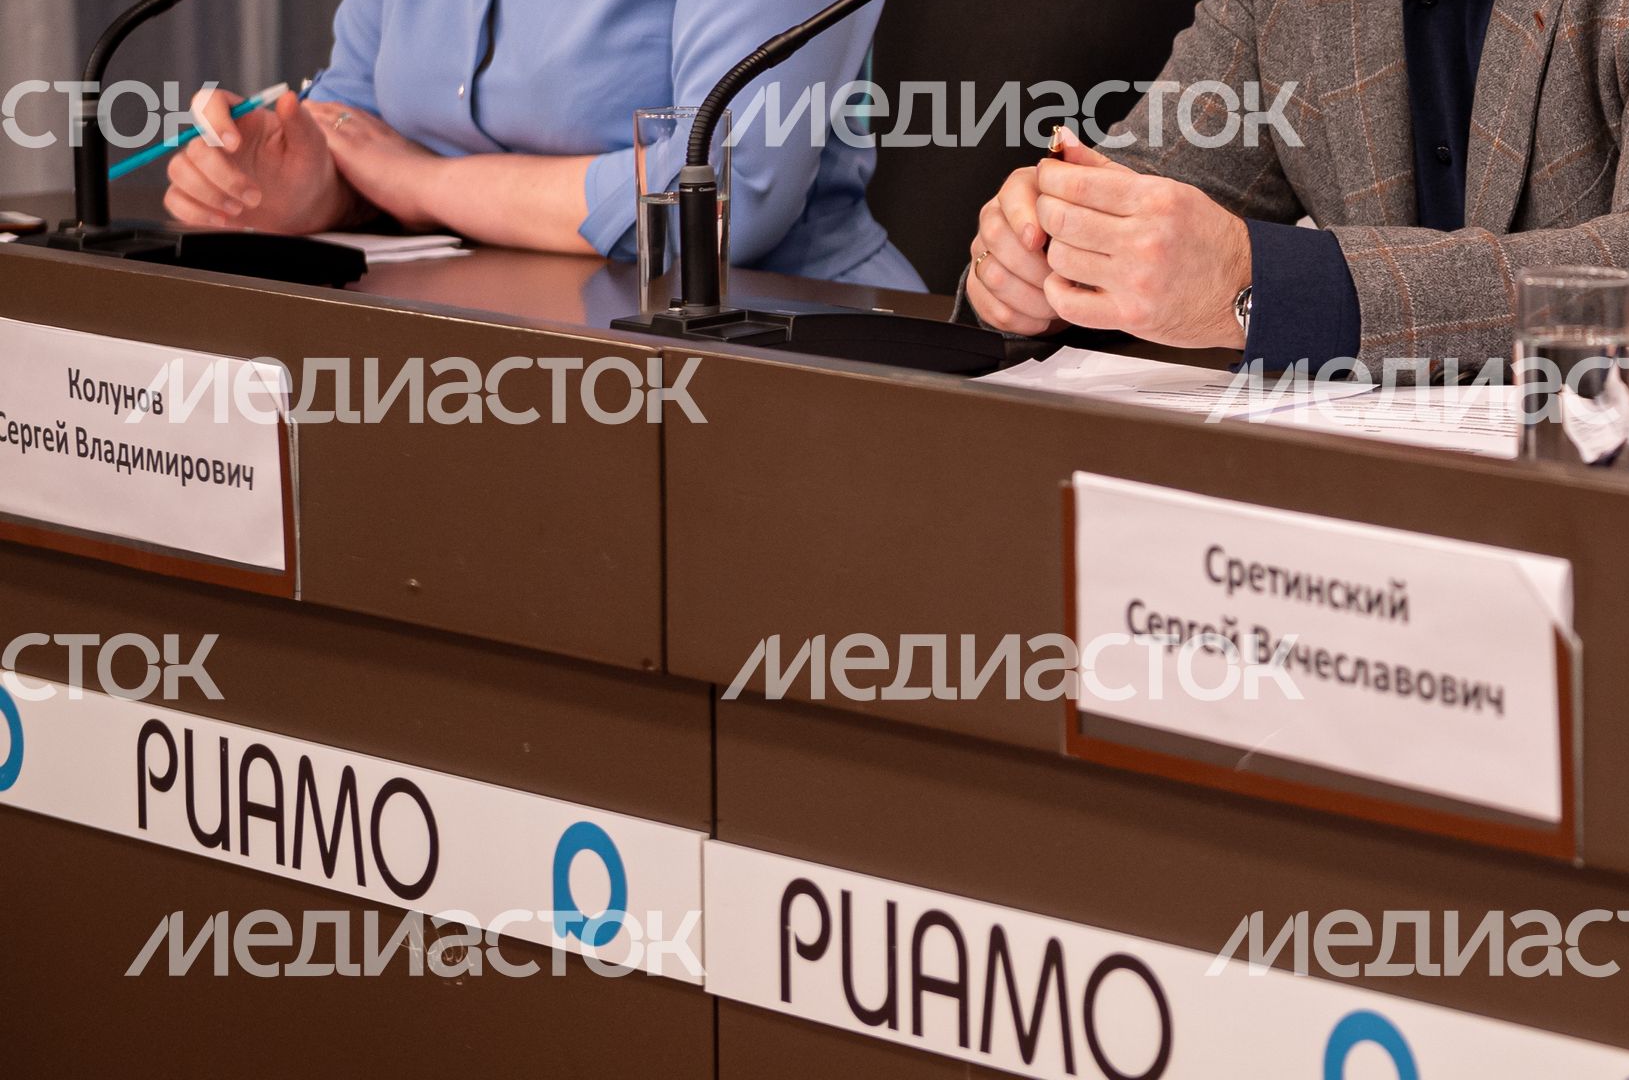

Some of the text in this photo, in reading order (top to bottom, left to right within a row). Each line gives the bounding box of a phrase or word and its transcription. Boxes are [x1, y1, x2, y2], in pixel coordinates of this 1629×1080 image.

[68, 367, 163, 415] Колунов
[75, 426, 254, 490] Владимирович
[1205, 545, 1411, 623] Сретинский
[1126, 598, 1240, 658] Сергей
